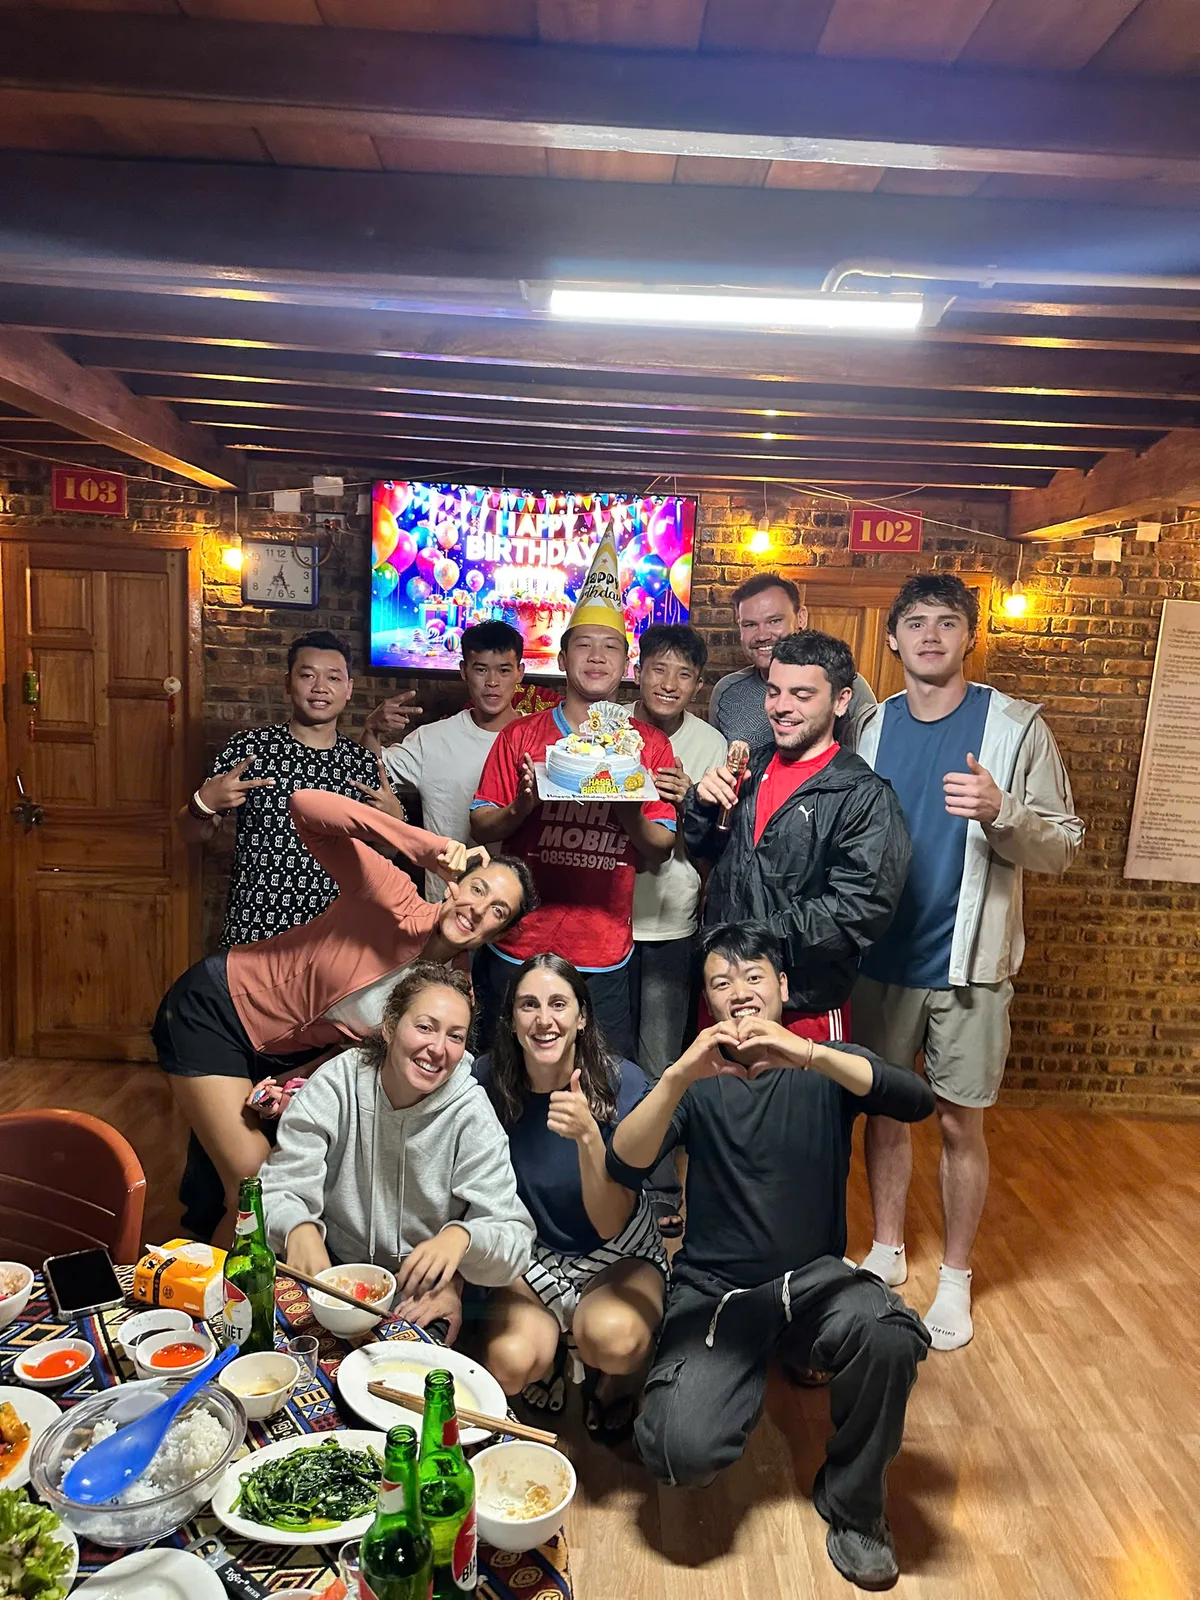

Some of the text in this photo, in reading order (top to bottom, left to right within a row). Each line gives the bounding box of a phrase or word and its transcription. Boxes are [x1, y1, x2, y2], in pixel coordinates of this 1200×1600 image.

[64, 477, 117, 503] 103
[496, 511, 578, 538] HAPPY
[860, 520, 912, 542] 102
[277, 550, 286, 558] 12
[466, 534, 600, 567] BIRTHDAY
[252, 582, 258, 590] 8
[304, 572, 310, 580] 3
[290, 590, 296, 598] 5
[541, 801, 611, 827] LINH
[538, 825, 630, 855] MOBILE
[540, 849, 617, 871] 0855539789
[224, 1566, 260, 1598] Tiger BEER
